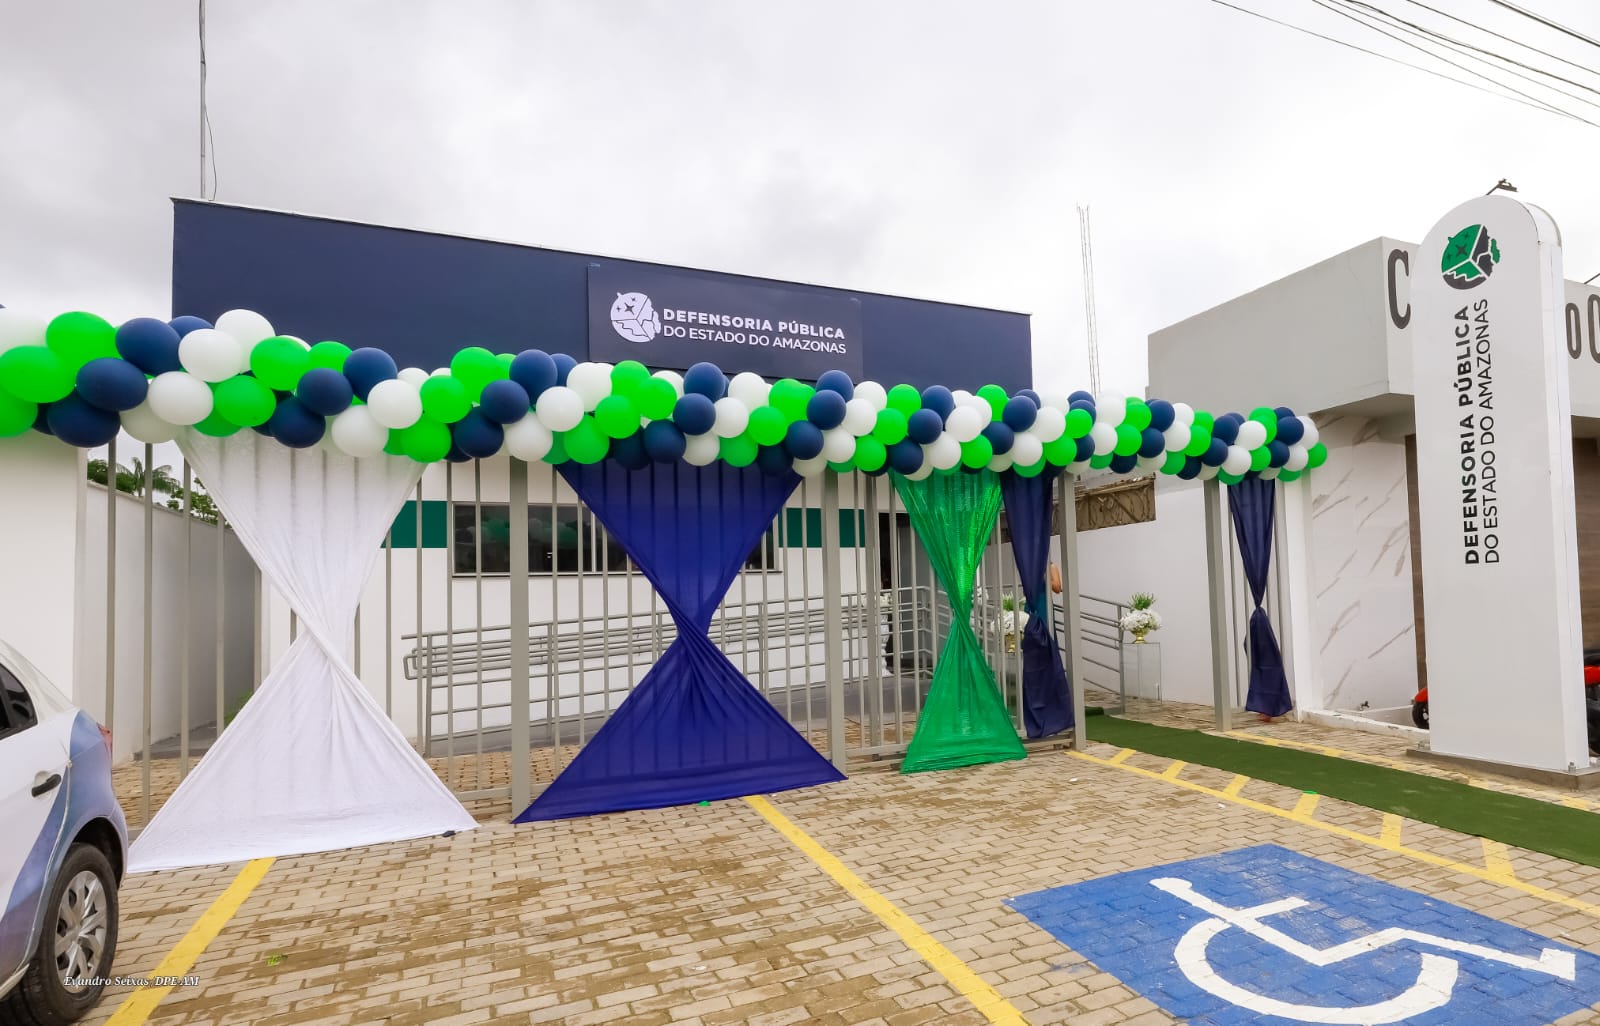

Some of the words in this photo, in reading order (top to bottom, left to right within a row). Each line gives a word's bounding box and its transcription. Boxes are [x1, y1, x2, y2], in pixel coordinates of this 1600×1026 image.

[663, 308, 773, 331] DEFENSORIA
[778, 320, 845, 340] PÚBLICA
[663, 325, 686, 338] DO
[689, 328, 746, 344] ESTADO
[749, 334, 770, 346] DO
[772, 336, 847, 354] AMAZONAS
[1454, 305, 1473, 407] PÚBLICA
[1474, 299, 1494, 410] AMAZONAS
[1479, 415, 1495, 445] DO
[1459, 413, 1479, 564] DEFENSORIA
[1481, 450, 1498, 528] ESTADO
[1485, 534, 1500, 564] DO
